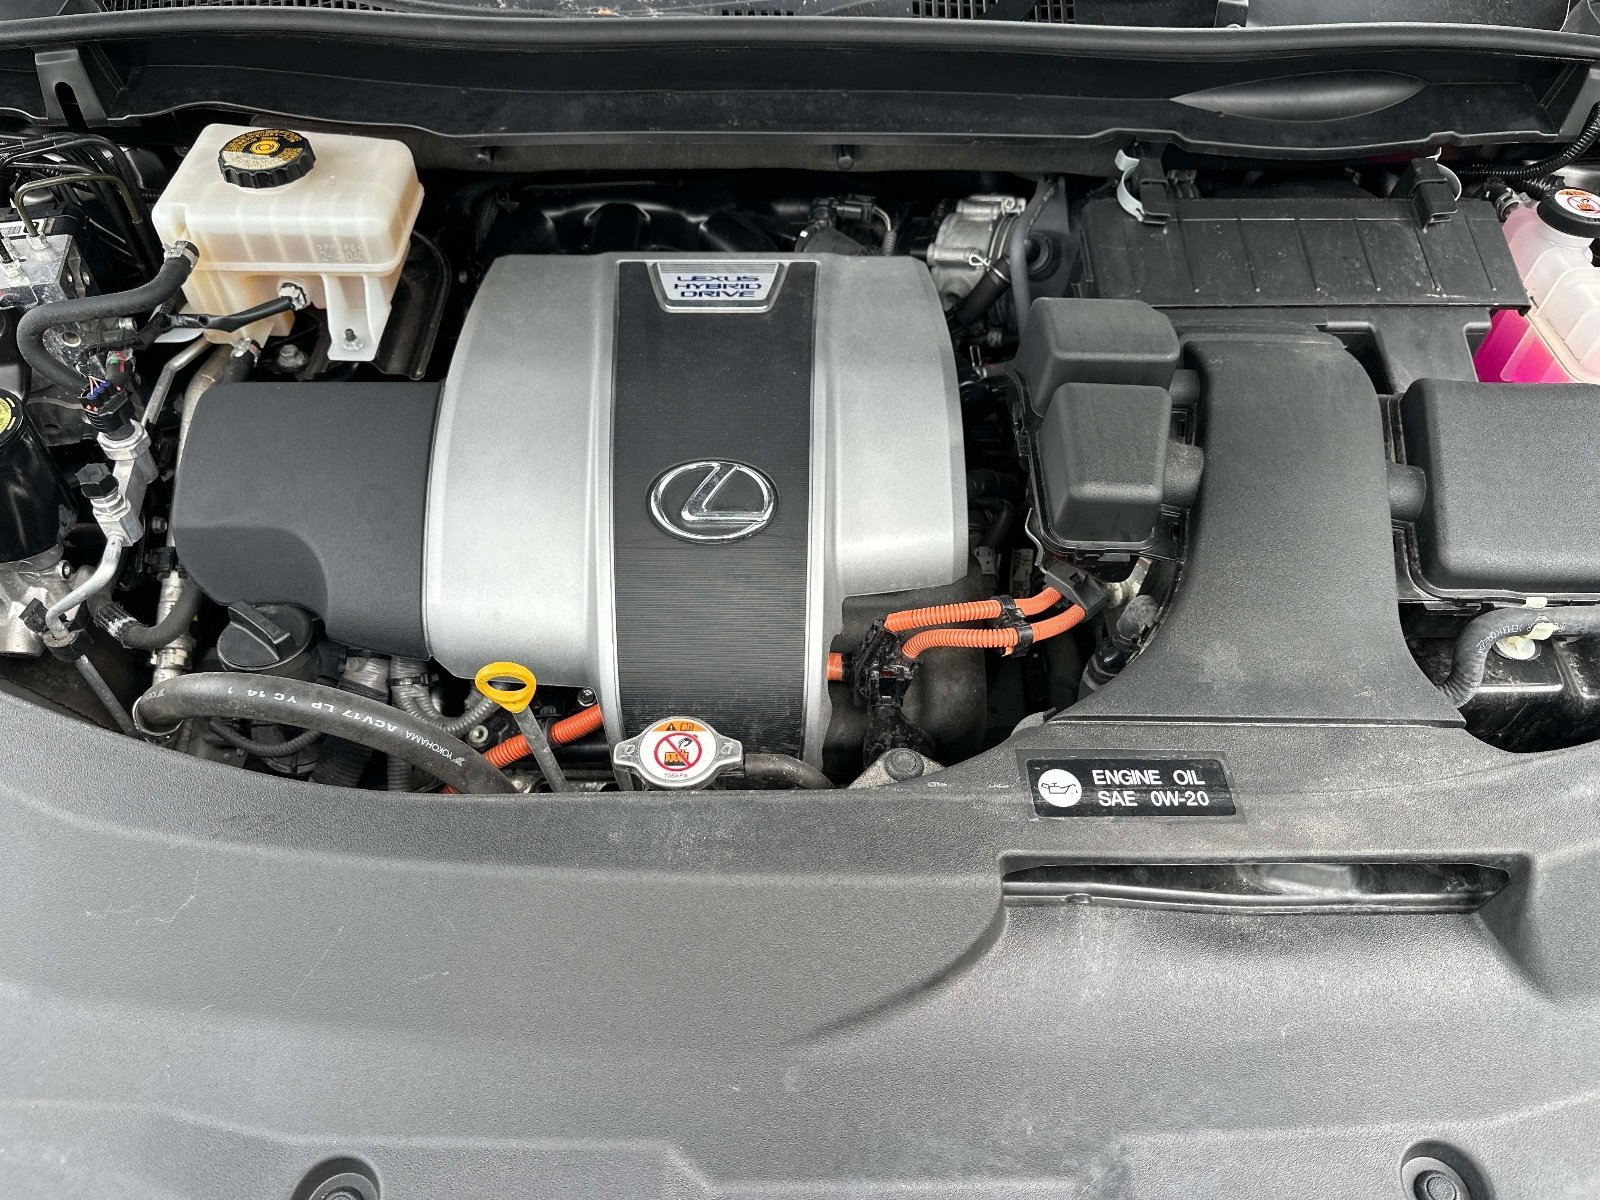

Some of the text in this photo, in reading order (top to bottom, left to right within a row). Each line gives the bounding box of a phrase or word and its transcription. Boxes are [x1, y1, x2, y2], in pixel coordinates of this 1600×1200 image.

[680, 290, 755, 298] DRIVE
[273, 692, 297, 704] YC
[311, 701, 335, 713] LP
[341, 709, 398, 732] ACV17
[405, 730, 454, 760] YOKOHAMA
[1091, 769, 1206, 785] ENGINE OIL
[1098, 791, 1210, 807] SAE 0W-20
